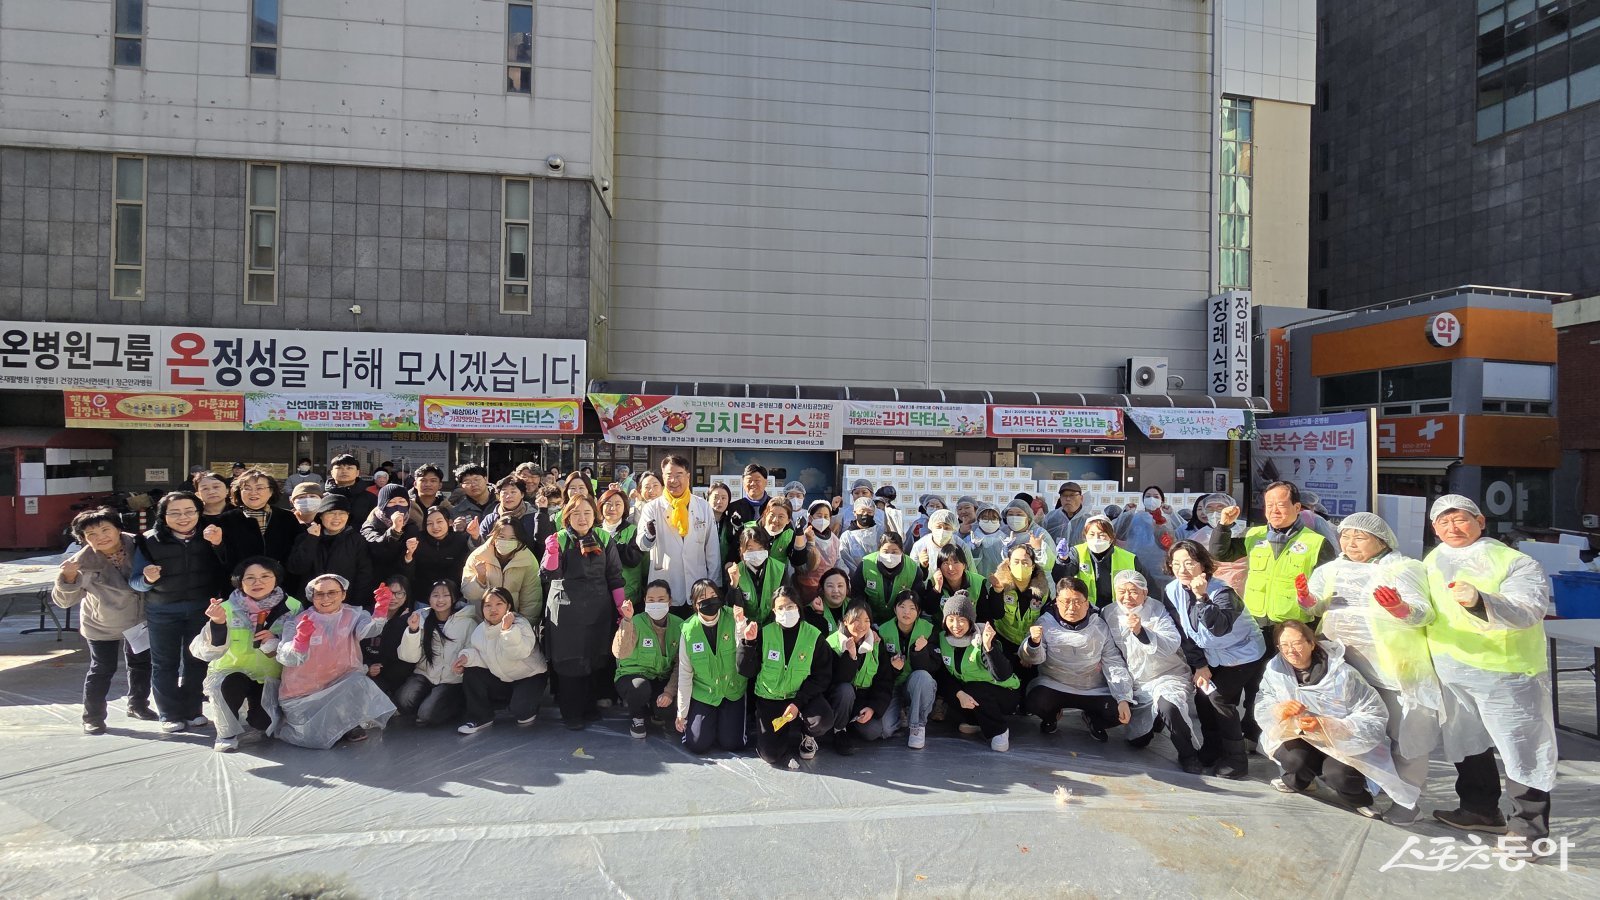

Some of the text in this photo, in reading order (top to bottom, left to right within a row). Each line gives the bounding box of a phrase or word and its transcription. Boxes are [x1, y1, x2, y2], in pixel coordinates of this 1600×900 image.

[1435, 317, 1456, 344] 약
[0, 328, 154, 373] 온병원그룹
[1212, 297, 1230, 394] 장례식장
[1234, 296, 1250, 393] 장례식장
[166, 331, 581, 395] 온정성을 다해 모시겠습니다
[198, 397, 240, 410] 다문화와
[286, 400, 384, 412] 신선마을과 함께하는
[297, 411, 374, 422] 사랑의 김장나눔
[451, 408, 478, 417] 세상에서
[481, 408, 555, 424] 김치닥터스
[808, 412, 831, 421] 사랑은
[848, 409, 877, 418] 세상에서
[882, 411, 950, 428] 김치닥터스
[1195, 415, 1216, 426] 사랑
[621, 413, 660, 433] 김장하는
[694, 411, 808, 436] 김치닥터스
[808, 421, 831, 430] 김치를
[1001, 415, 1106, 429] 김치닥터스 김장나눔
[1258, 428, 1355, 452] 로봇수술센터
